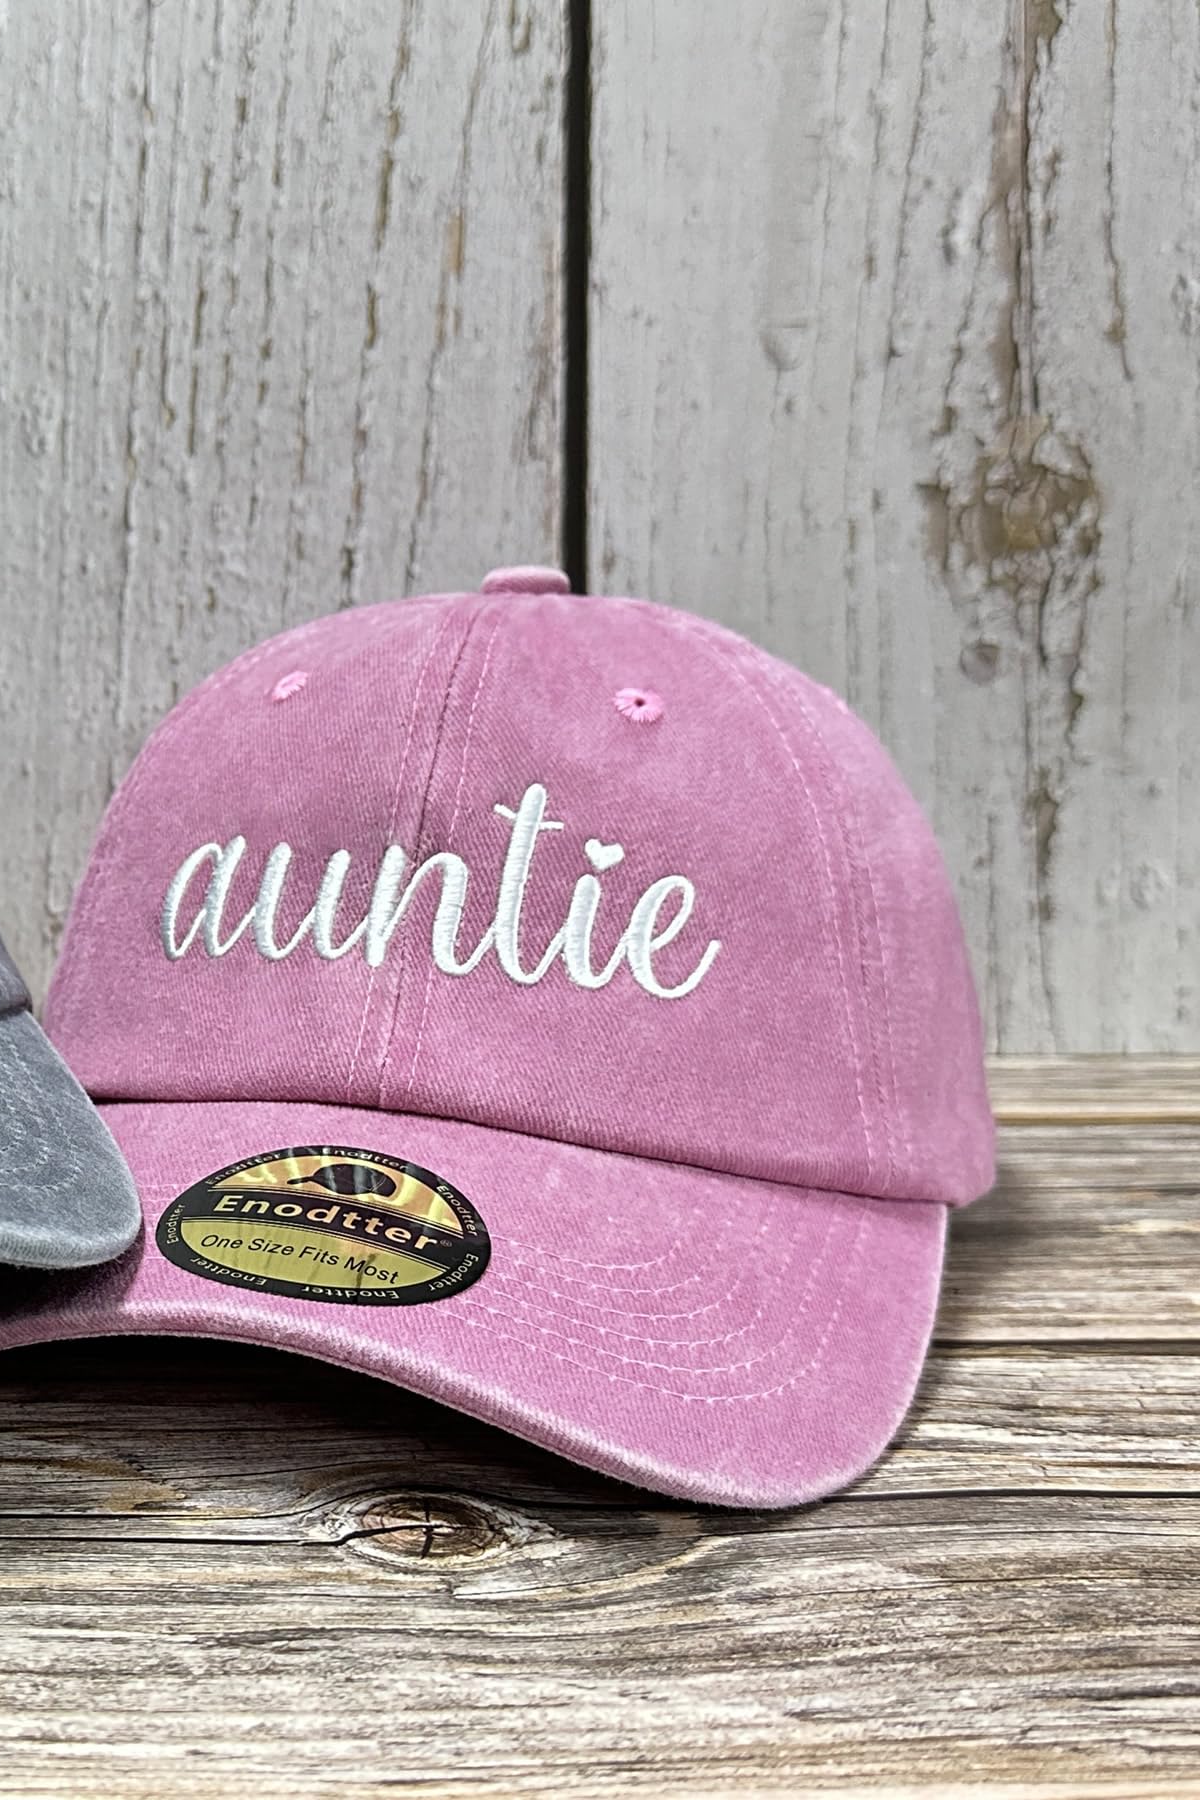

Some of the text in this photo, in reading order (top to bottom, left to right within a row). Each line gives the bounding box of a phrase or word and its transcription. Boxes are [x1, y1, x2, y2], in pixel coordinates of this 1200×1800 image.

[161, 783, 721, 1000] auntie
[205, 1153, 281, 1186] Enodtter
[166, 1203, 186, 1245] Enodtter
[436, 1184, 478, 1236] Enodtter
[190, 1257, 268, 1286] Enodtter
[200, 1234, 400, 1285] One Size Fits Most
[428, 1252, 480, 1291] Enodtter
[301, 1285, 400, 1299] Enodtter
